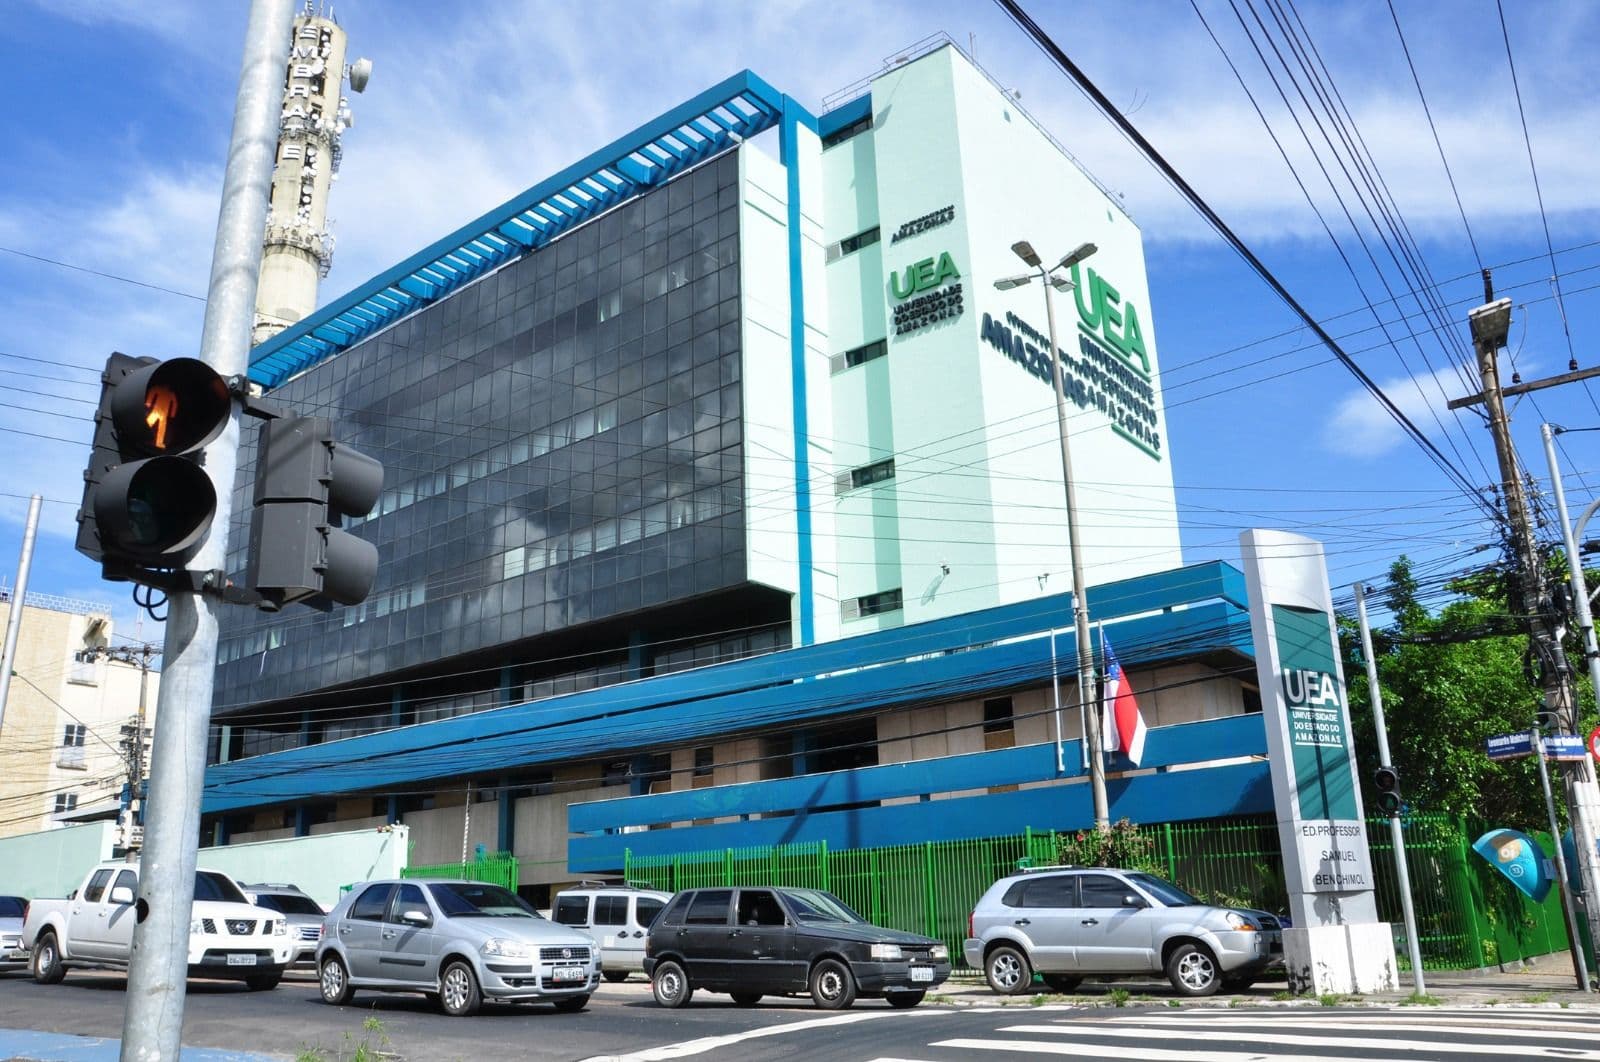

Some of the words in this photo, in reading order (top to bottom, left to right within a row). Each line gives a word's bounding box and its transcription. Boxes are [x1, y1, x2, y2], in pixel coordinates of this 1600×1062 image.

[891, 211, 955, 244] AMAZONAS
[890, 251, 961, 300] UEA
[893, 283, 962, 315] UNIVERSIDADE
[894, 313, 909, 325] DO
[909, 300, 946, 320] ESTADO
[947, 294, 963, 306] DO
[896, 305, 964, 335] AMAZONAS
[1071, 263, 1151, 374] UEA
[1079, 334, 1155, 405] UNIVERSIDADE
[1100, 371, 1141, 417] ESTADO
[1087, 385, 1161, 451] AMAZONAS
[1284, 669, 1339, 706] UEA
[1292, 711, 1338, 722] UNIVERSIDADE
[1295, 722, 1304, 730] DO
[1304, 722, 1329, 732] ESTADO
[1330, 724, 1340, 732] DO
[1295, 733, 1341, 743] AMAZONAS
[1321, 850, 1357, 862] SAMUEL
[1315, 874, 1365, 885] BENCHIMOL
